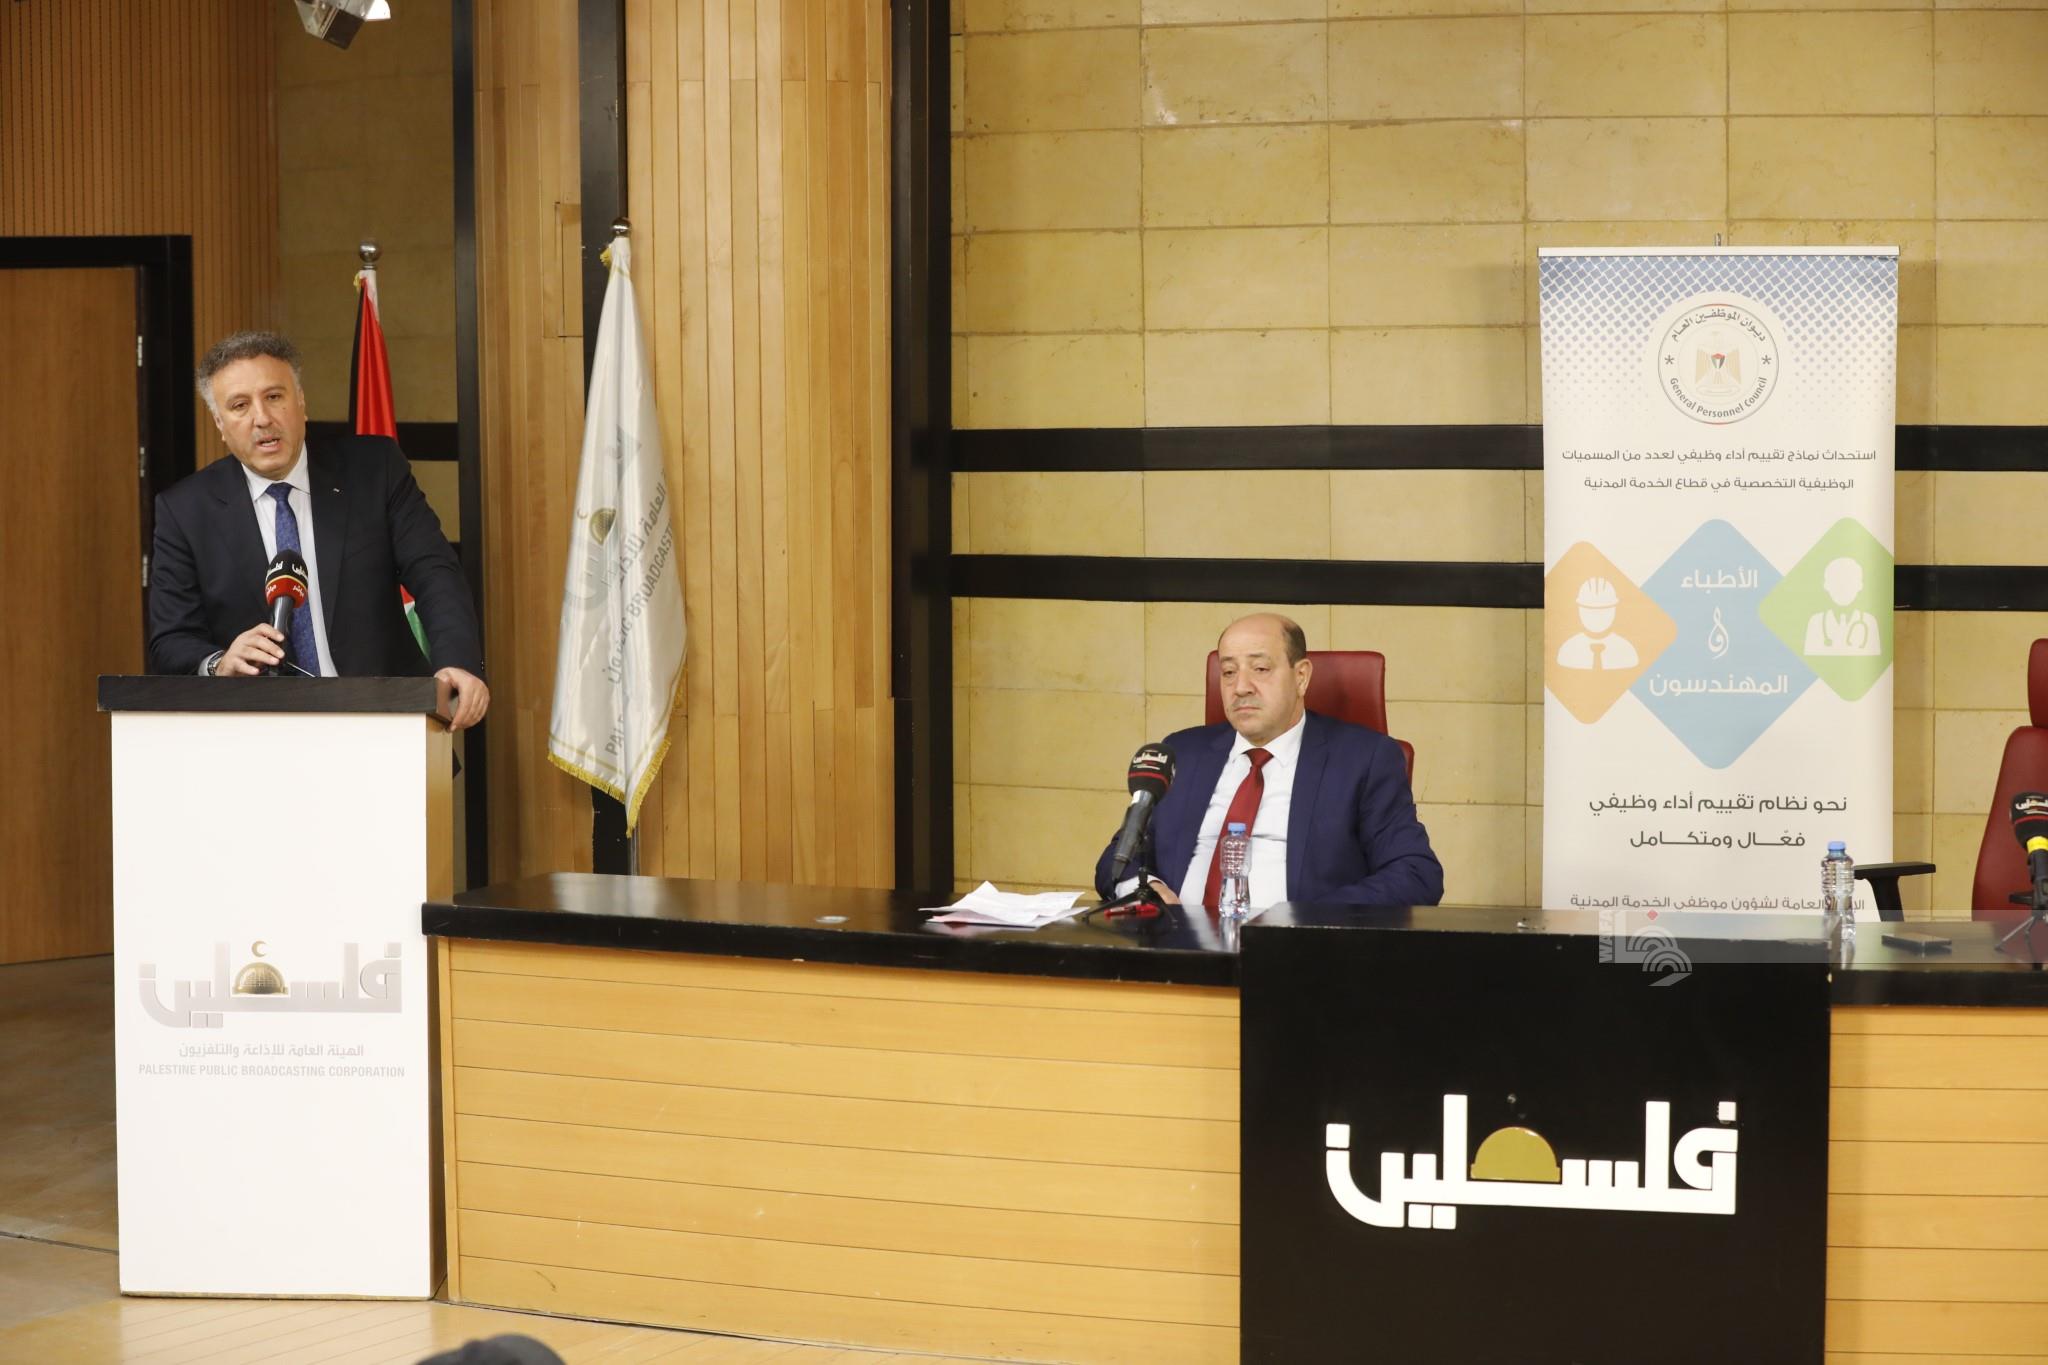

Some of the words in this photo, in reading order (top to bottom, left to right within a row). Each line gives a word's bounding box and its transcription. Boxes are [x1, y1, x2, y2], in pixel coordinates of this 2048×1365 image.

[1694, 308, 1740, 324] الموظفين
[1671, 318, 1693, 342] العام
[1739, 318, 1766, 342] ديوان
[1670, 377, 1697, 410] General
[1696, 403, 1744, 418] Personnel
[1744, 376, 1768, 408] Council
[1561, 450, 1620, 463] المسميات
[1622, 450, 1641, 463] من
[1645, 449, 1675, 462] لعدد
[1678, 449, 1722, 465] وظيفي
[1725, 447, 1746, 461] أداء
[1747, 449, 1785, 464] تقييم
[1787, 449, 1820, 464] نماذج
[1822, 449, 1877, 462] استحداث
[1583, 477, 1627, 491] المدنية
[1629, 477, 1672, 490] الخدمة
[1675, 477, 1708, 490] قطاع
[1710, 478, 1731, 494] في
[1734, 477, 1796, 491] التخصصية
[1798, 477, 1854, 491] الوظيفية
[1680, 566, 1758, 594] الأطباء
[1649, 674, 1788, 697] المهندسون
[1588, 792, 1658, 817] وظيفي
[1662, 790, 1693, 810] أداء
[1697, 793, 1755, 815] تقييم
[1758, 795, 1807, 814] نظام
[1813, 796, 1848, 814] نحو
[1570, 894, 1619, 910] المدنية
[1621, 894, 1671, 908] الخدمة
[1730, 896, 1779, 911] لشؤون
[1781, 896, 1826, 911] العامة
[138, 941, 402, 1029] فلسطين
[178, 1042, 240, 1059] والتلفزيون
[288, 1043, 324, 1058] العامة
[326, 1044, 364, 1060] الهيئة
[138, 1064, 197, 1076] PALESTINE
[199, 1064, 238, 1077] PUBLIC
[241, 1065, 326, 1078] BROADCASTING
[328, 1066, 405, 1079] CORPORATION
[1326, 1094, 1739, 1230] فلسطين
